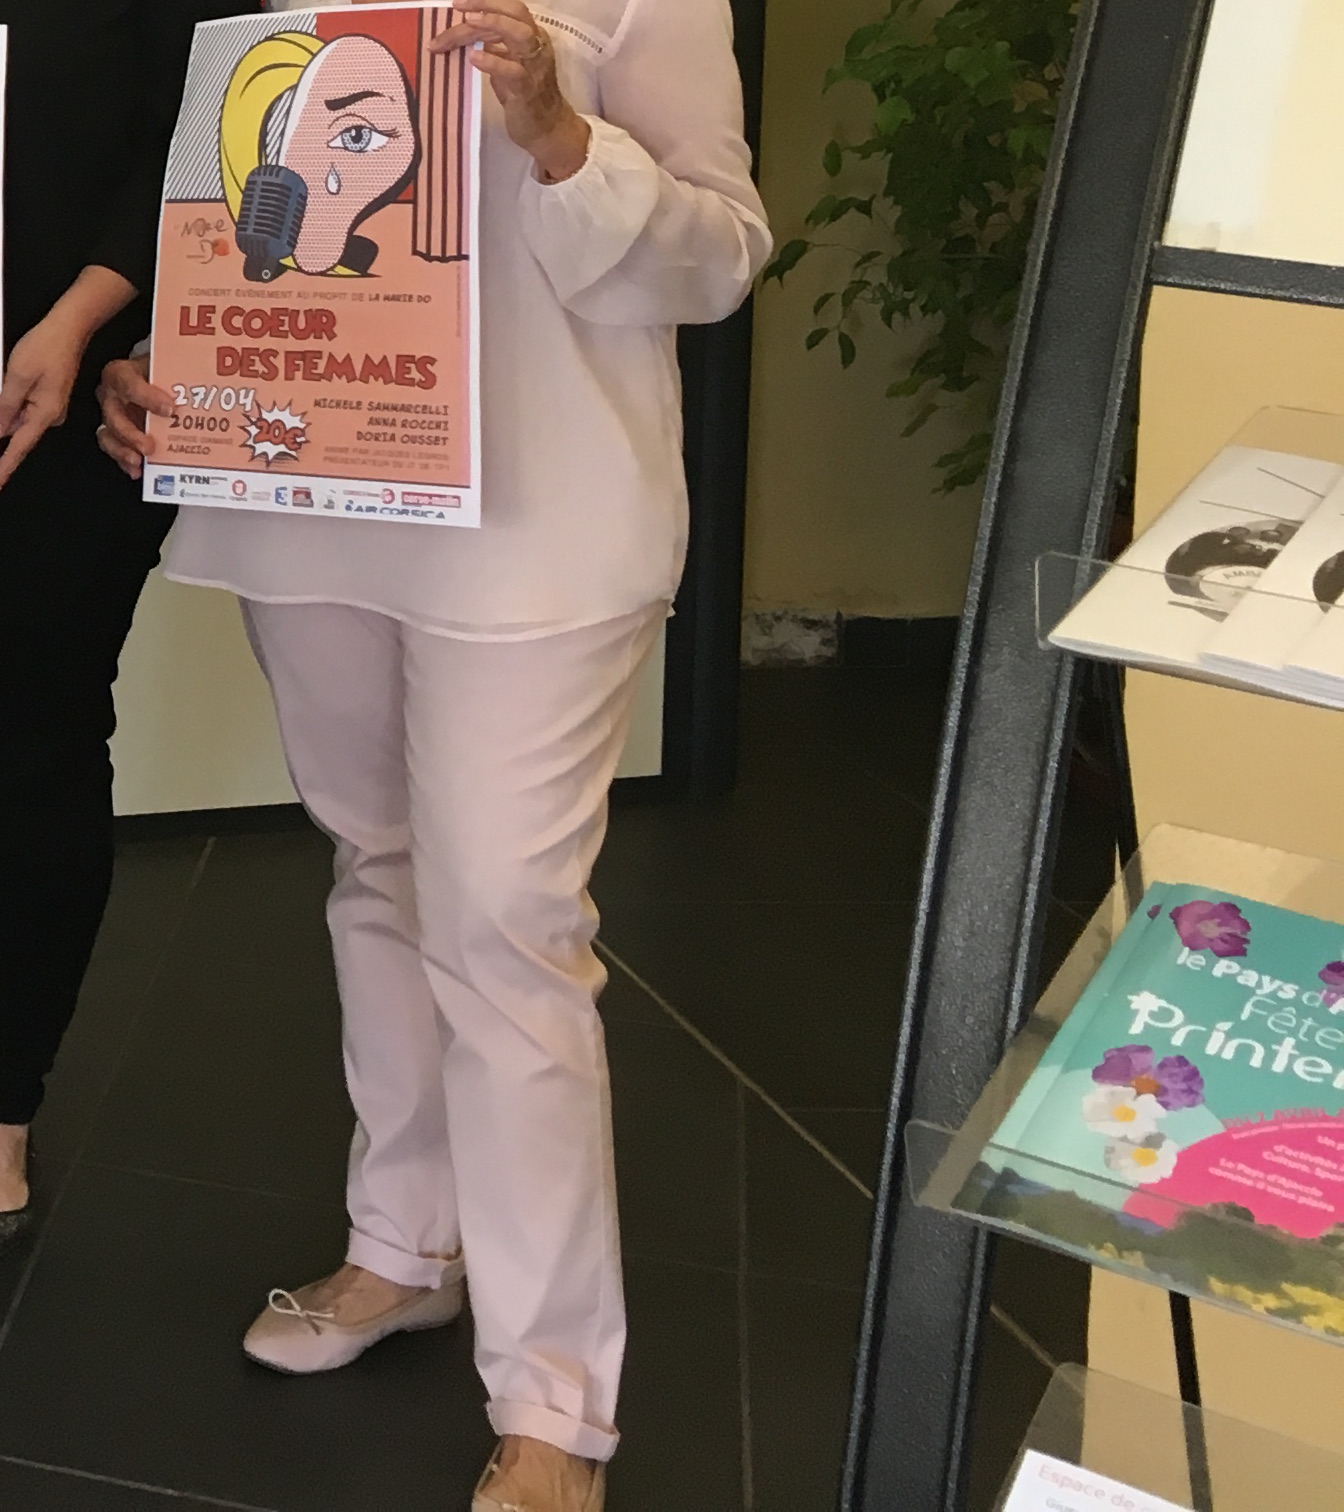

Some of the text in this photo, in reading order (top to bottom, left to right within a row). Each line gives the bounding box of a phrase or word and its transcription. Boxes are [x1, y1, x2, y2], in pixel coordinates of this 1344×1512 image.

[179, 305, 337, 341] LE COEUR
[216, 346, 437, 390] DES FEMMES
[172, 384, 256, 412] 27/04
[170, 414, 230, 433] 20H00
[254, 419, 305, 451] 20€
[1177, 947, 1299, 999] le Pays
[1241, 995, 1344, 1050] Fête
[1038, 1464, 1135, 1509] Espace de
